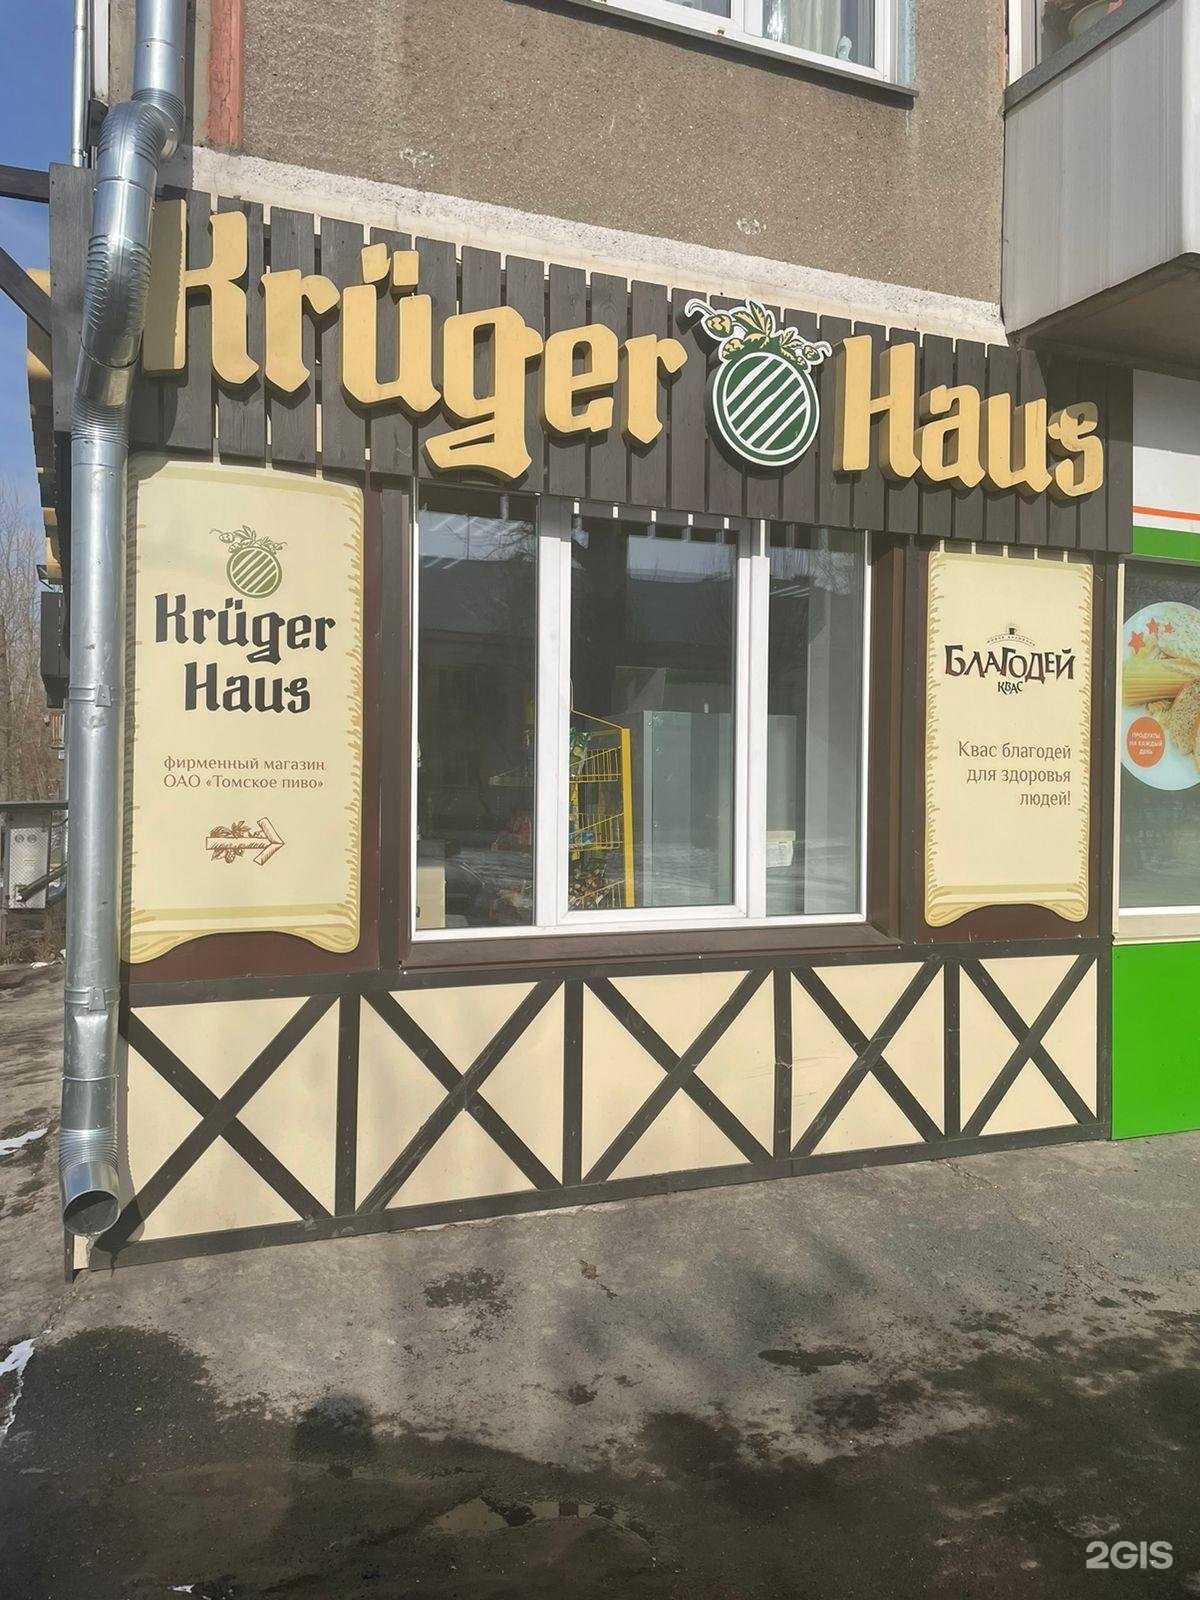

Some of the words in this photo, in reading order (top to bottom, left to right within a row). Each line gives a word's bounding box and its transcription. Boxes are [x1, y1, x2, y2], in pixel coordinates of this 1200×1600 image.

[143, 198, 688, 479] Krüger
[841, 334, 1104, 498] Haus
[154, 592, 336, 666] Krüger
[944, 644, 1077, 685] БЛАГОДЕЙ
[183, 661, 312, 714] Haus
[997, 681, 1024, 695] КВАС
[958, 741, 998, 759] Квас
[1001, 742, 1072, 762] благодей
[163, 756, 260, 772] фирменный
[263, 758, 326, 771] магазин
[163, 774, 201, 788] ОАО
[205, 774, 278, 789] «Томское
[282, 777, 324, 790] пиво»
[966, 769, 997, 783] для
[1000, 769, 1072, 786] здоровья
[1019, 790, 1072, 807] людей!
